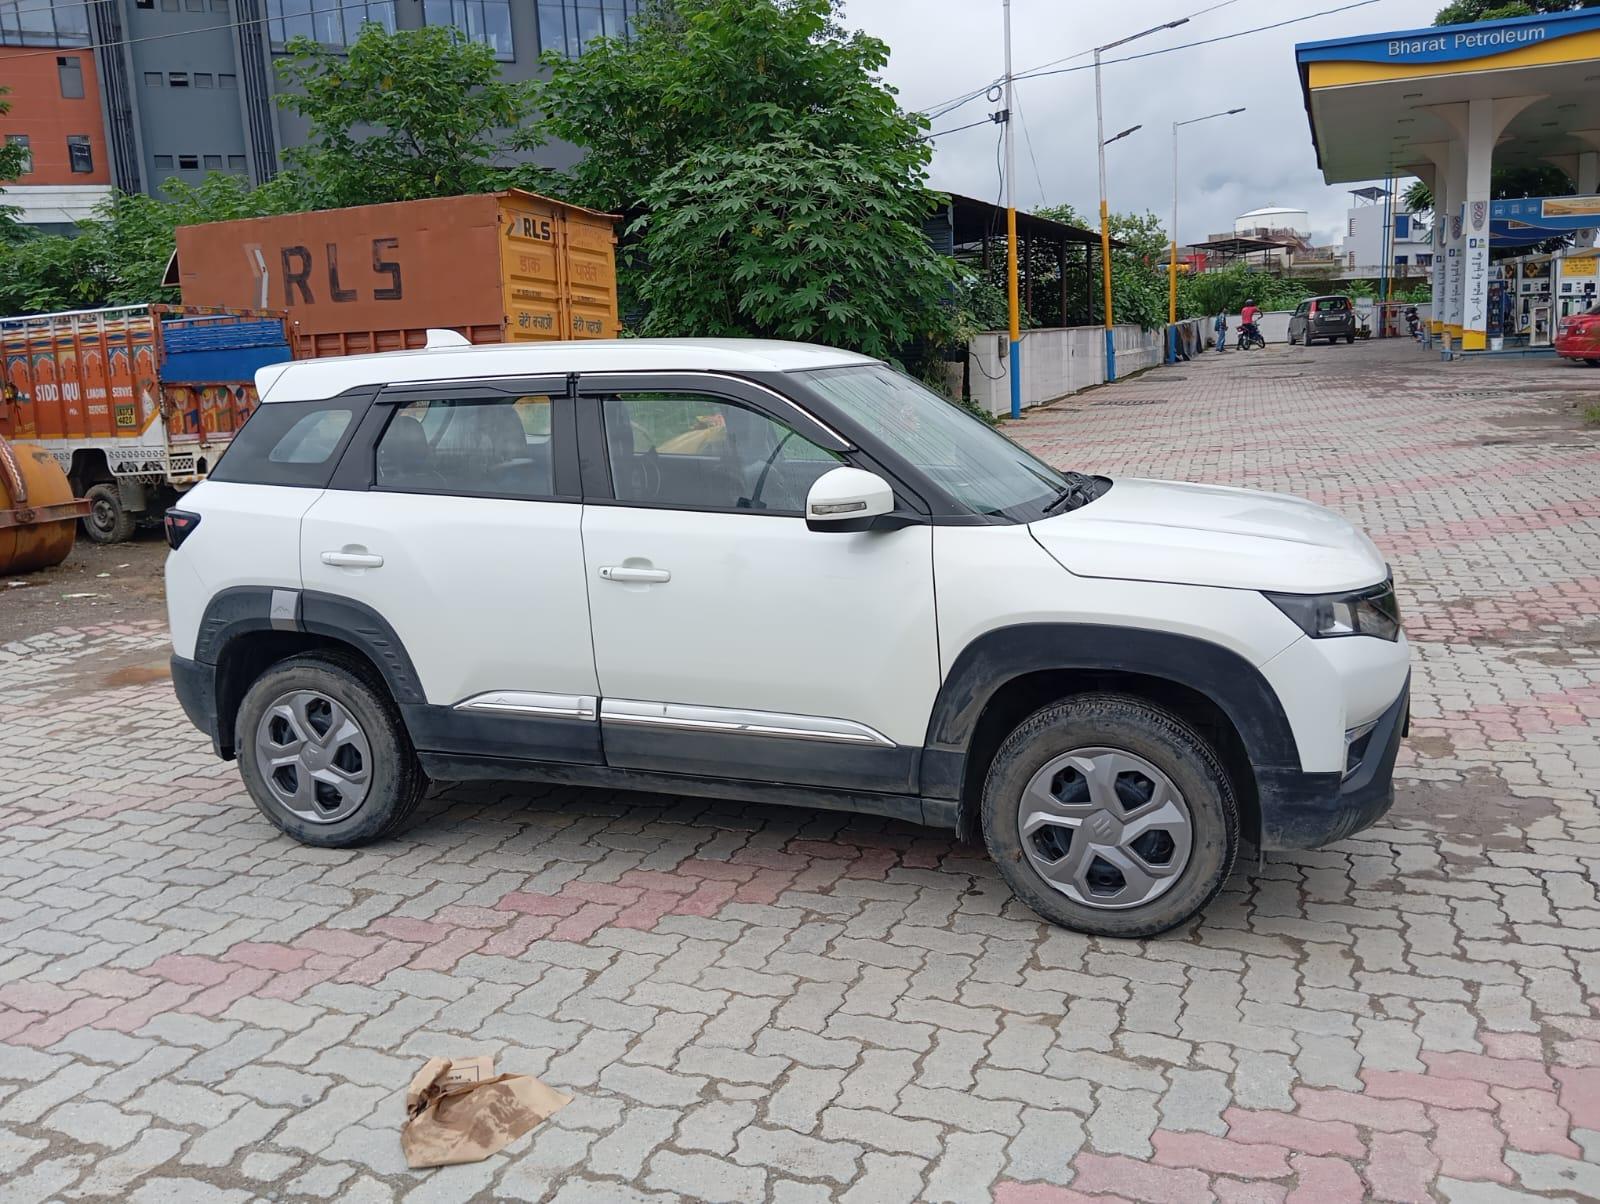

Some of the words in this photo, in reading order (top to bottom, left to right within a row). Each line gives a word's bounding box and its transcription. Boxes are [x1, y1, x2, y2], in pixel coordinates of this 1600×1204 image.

[1388, 36, 1447, 56] Bharat
[1455, 26, 1545, 49] Petroleum
[523, 218, 551, 240] RLS
[280, 238, 403, 305] RLS
